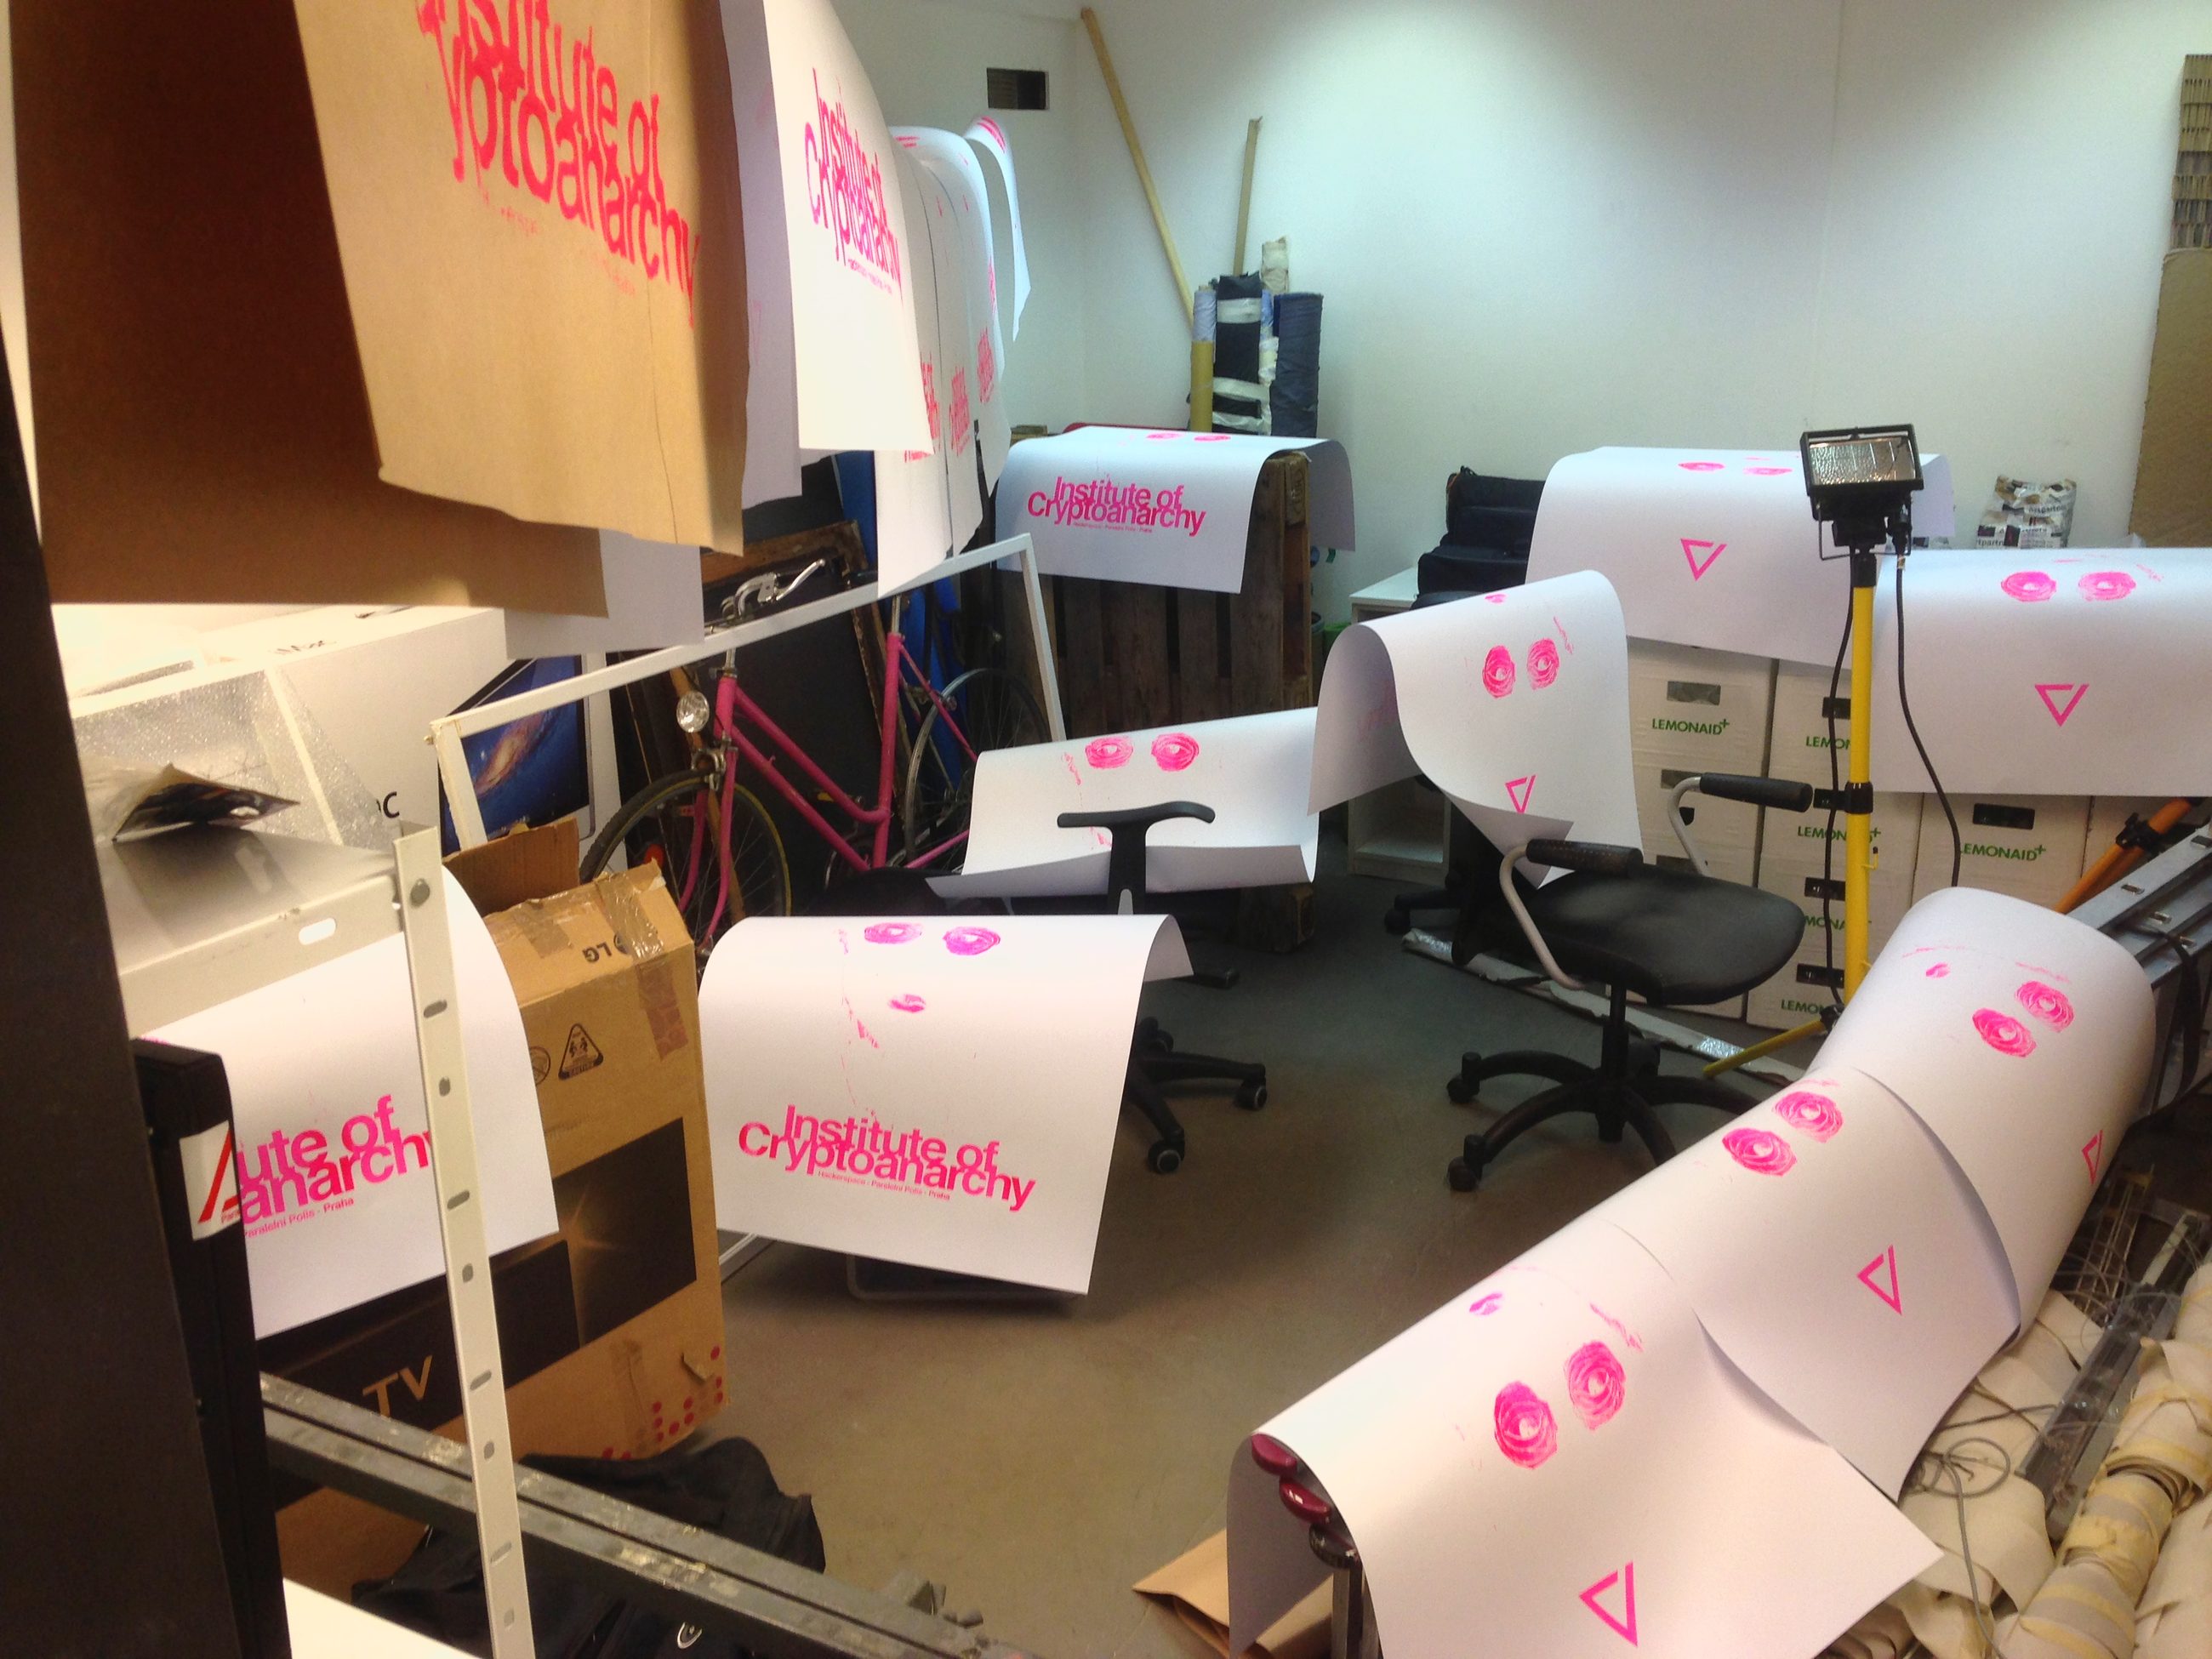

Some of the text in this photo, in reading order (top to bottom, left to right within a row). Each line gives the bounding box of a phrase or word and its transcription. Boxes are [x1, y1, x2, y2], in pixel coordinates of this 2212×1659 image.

[1028, 491, 1206, 537] Cryptoanarchy
[1054, 476, 1184, 510] Institute of
[582, 942, 612, 962] LG
[341, 1094, 394, 1152] of
[784, 1104, 1000, 1172] Institute of
[738, 1120, 1035, 1211] Cryptoanarchy
[323, 1197, 354, 1212] Praha
[362, 1354, 432, 1419] TV
